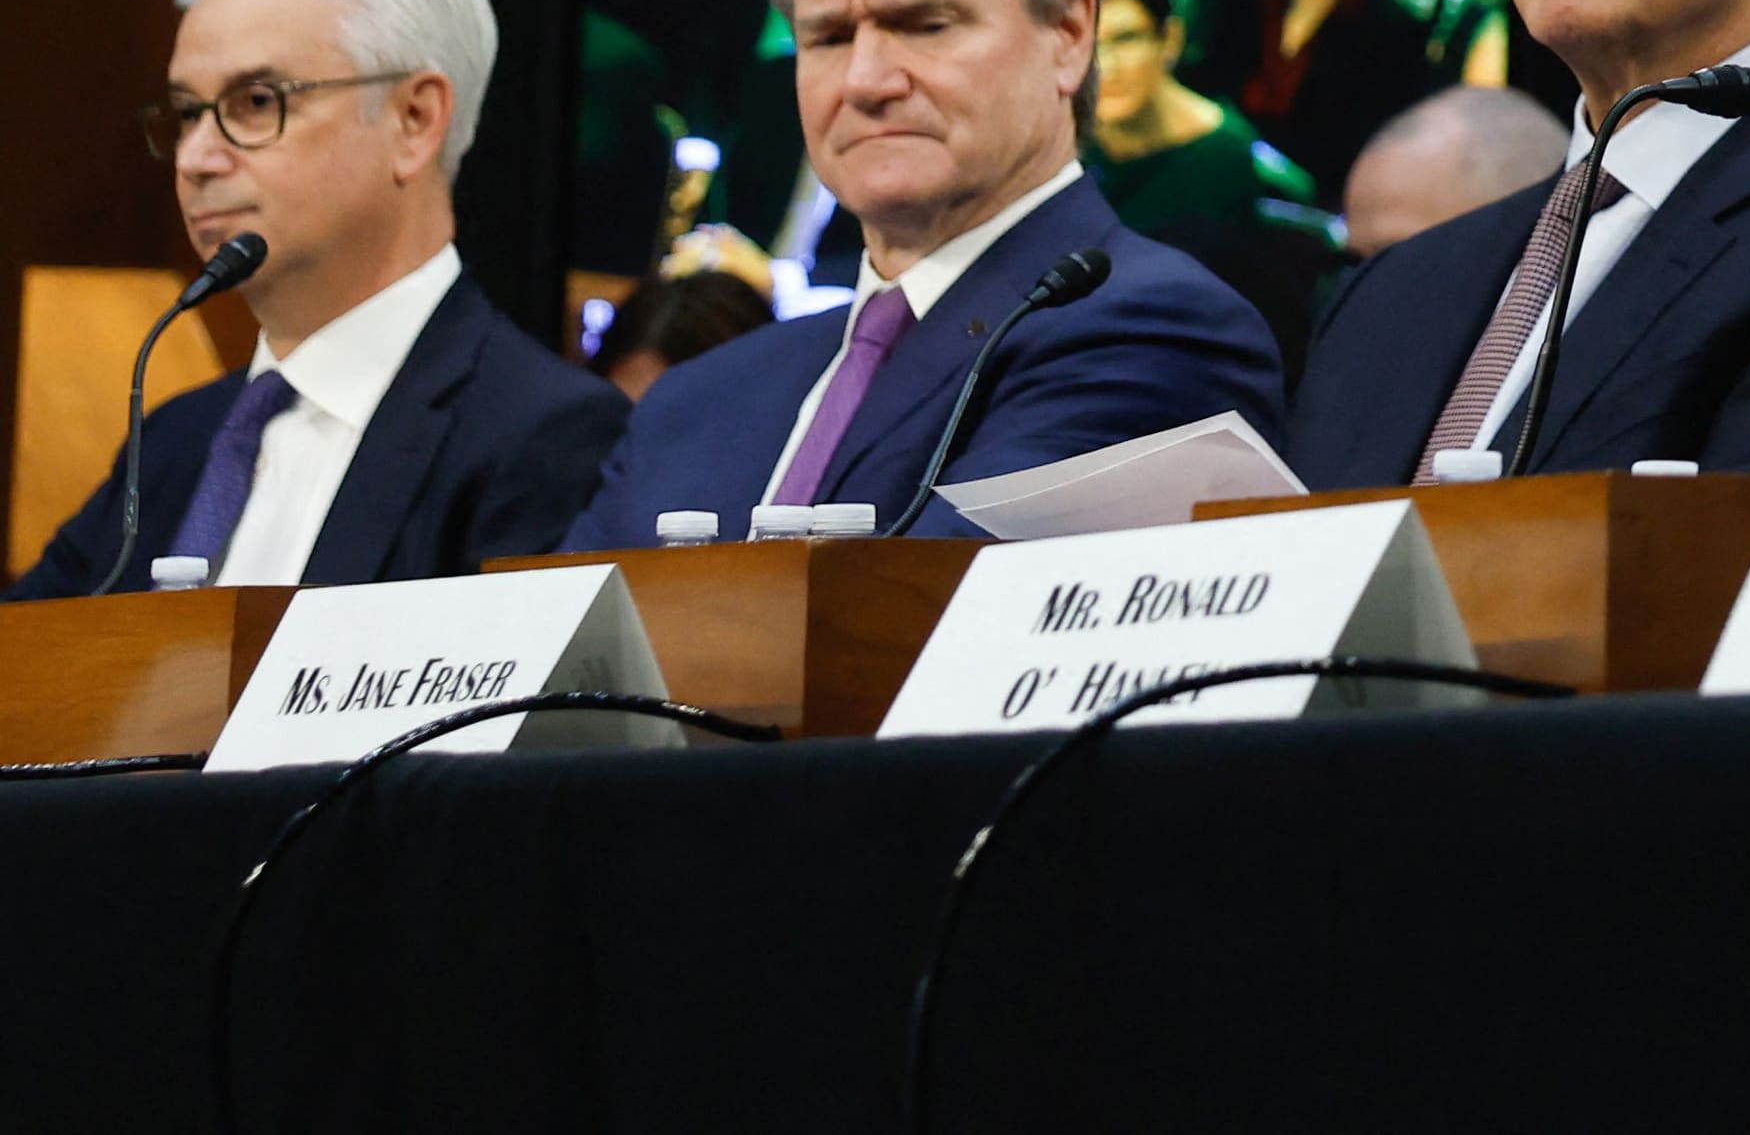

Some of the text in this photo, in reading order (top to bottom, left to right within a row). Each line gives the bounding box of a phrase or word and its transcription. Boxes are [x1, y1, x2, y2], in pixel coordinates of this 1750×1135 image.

[1113, 572, 1270, 626] RONALD
[337, 663, 411, 712] JANE
[406, 657, 516, 706] FRASER
